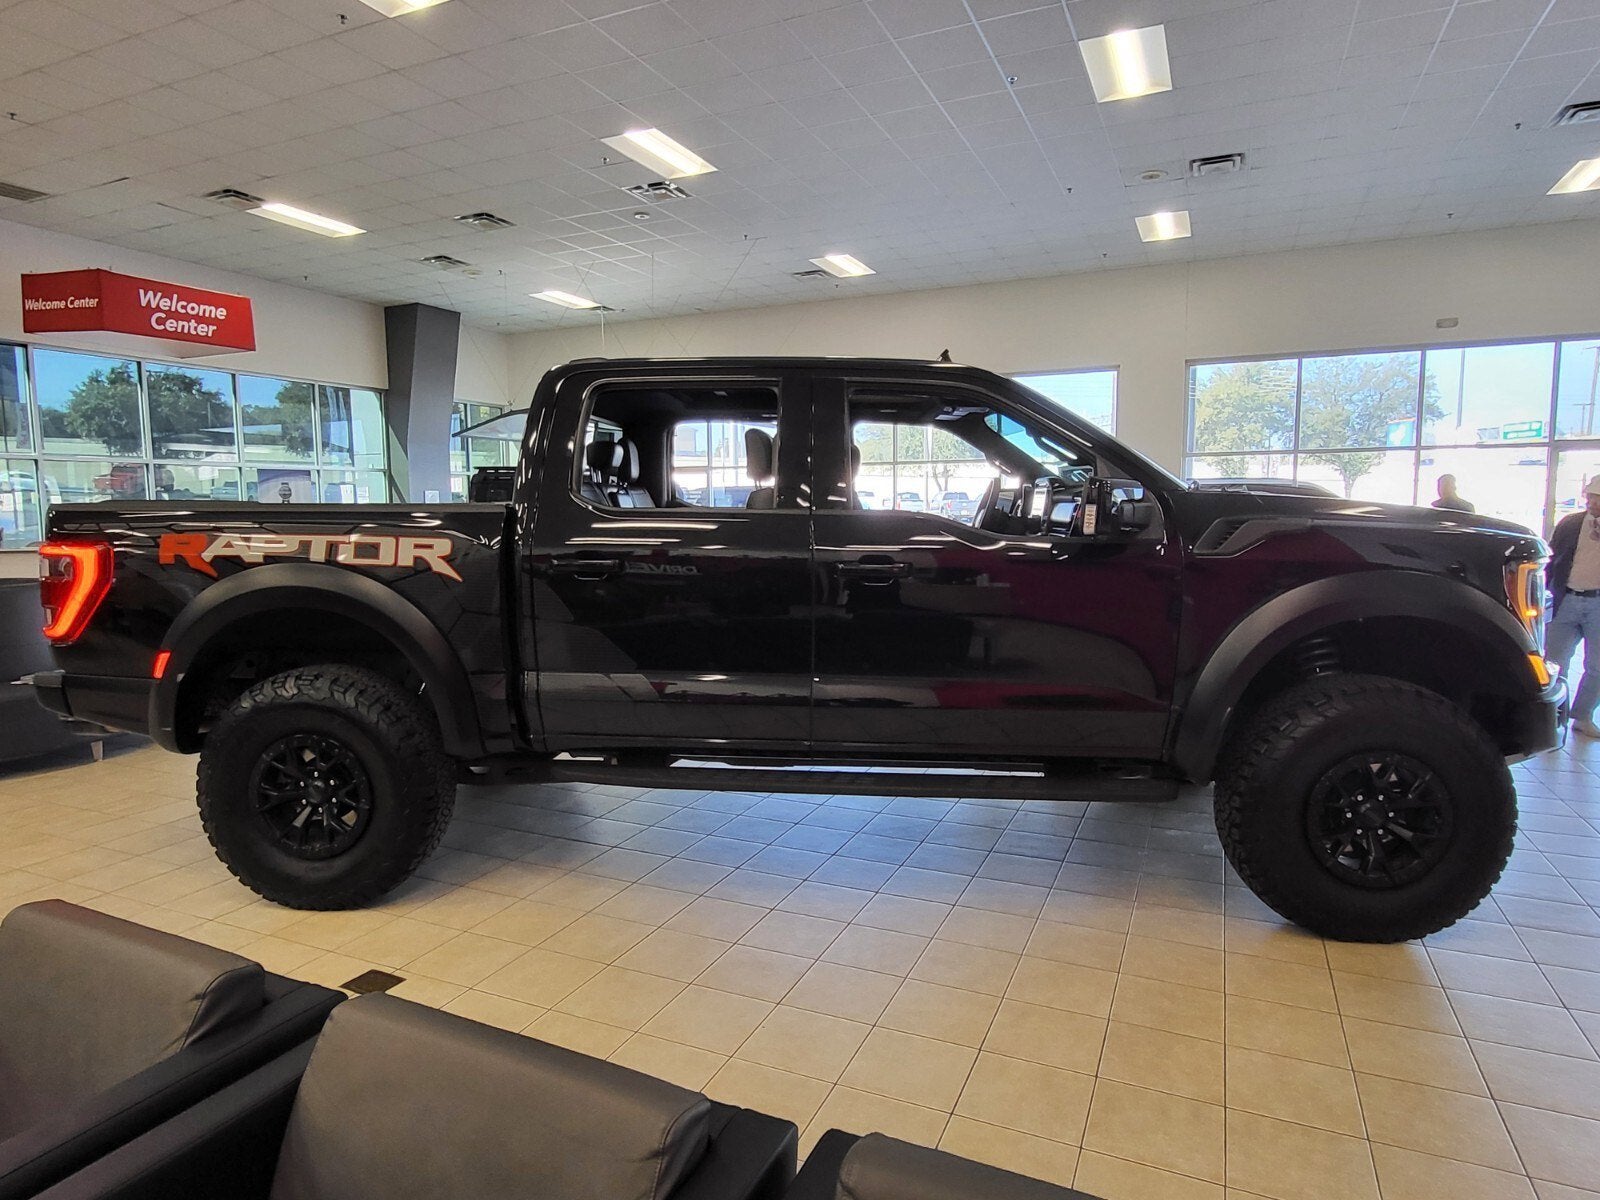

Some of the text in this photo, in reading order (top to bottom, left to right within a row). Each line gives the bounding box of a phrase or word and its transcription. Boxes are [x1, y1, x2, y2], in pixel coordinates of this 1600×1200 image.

[25, 295, 98, 310] Welcome Center
[139, 289, 227, 320] Welcome
[150, 312, 217, 337] Center
[159, 534, 462, 582] RAPTOR
